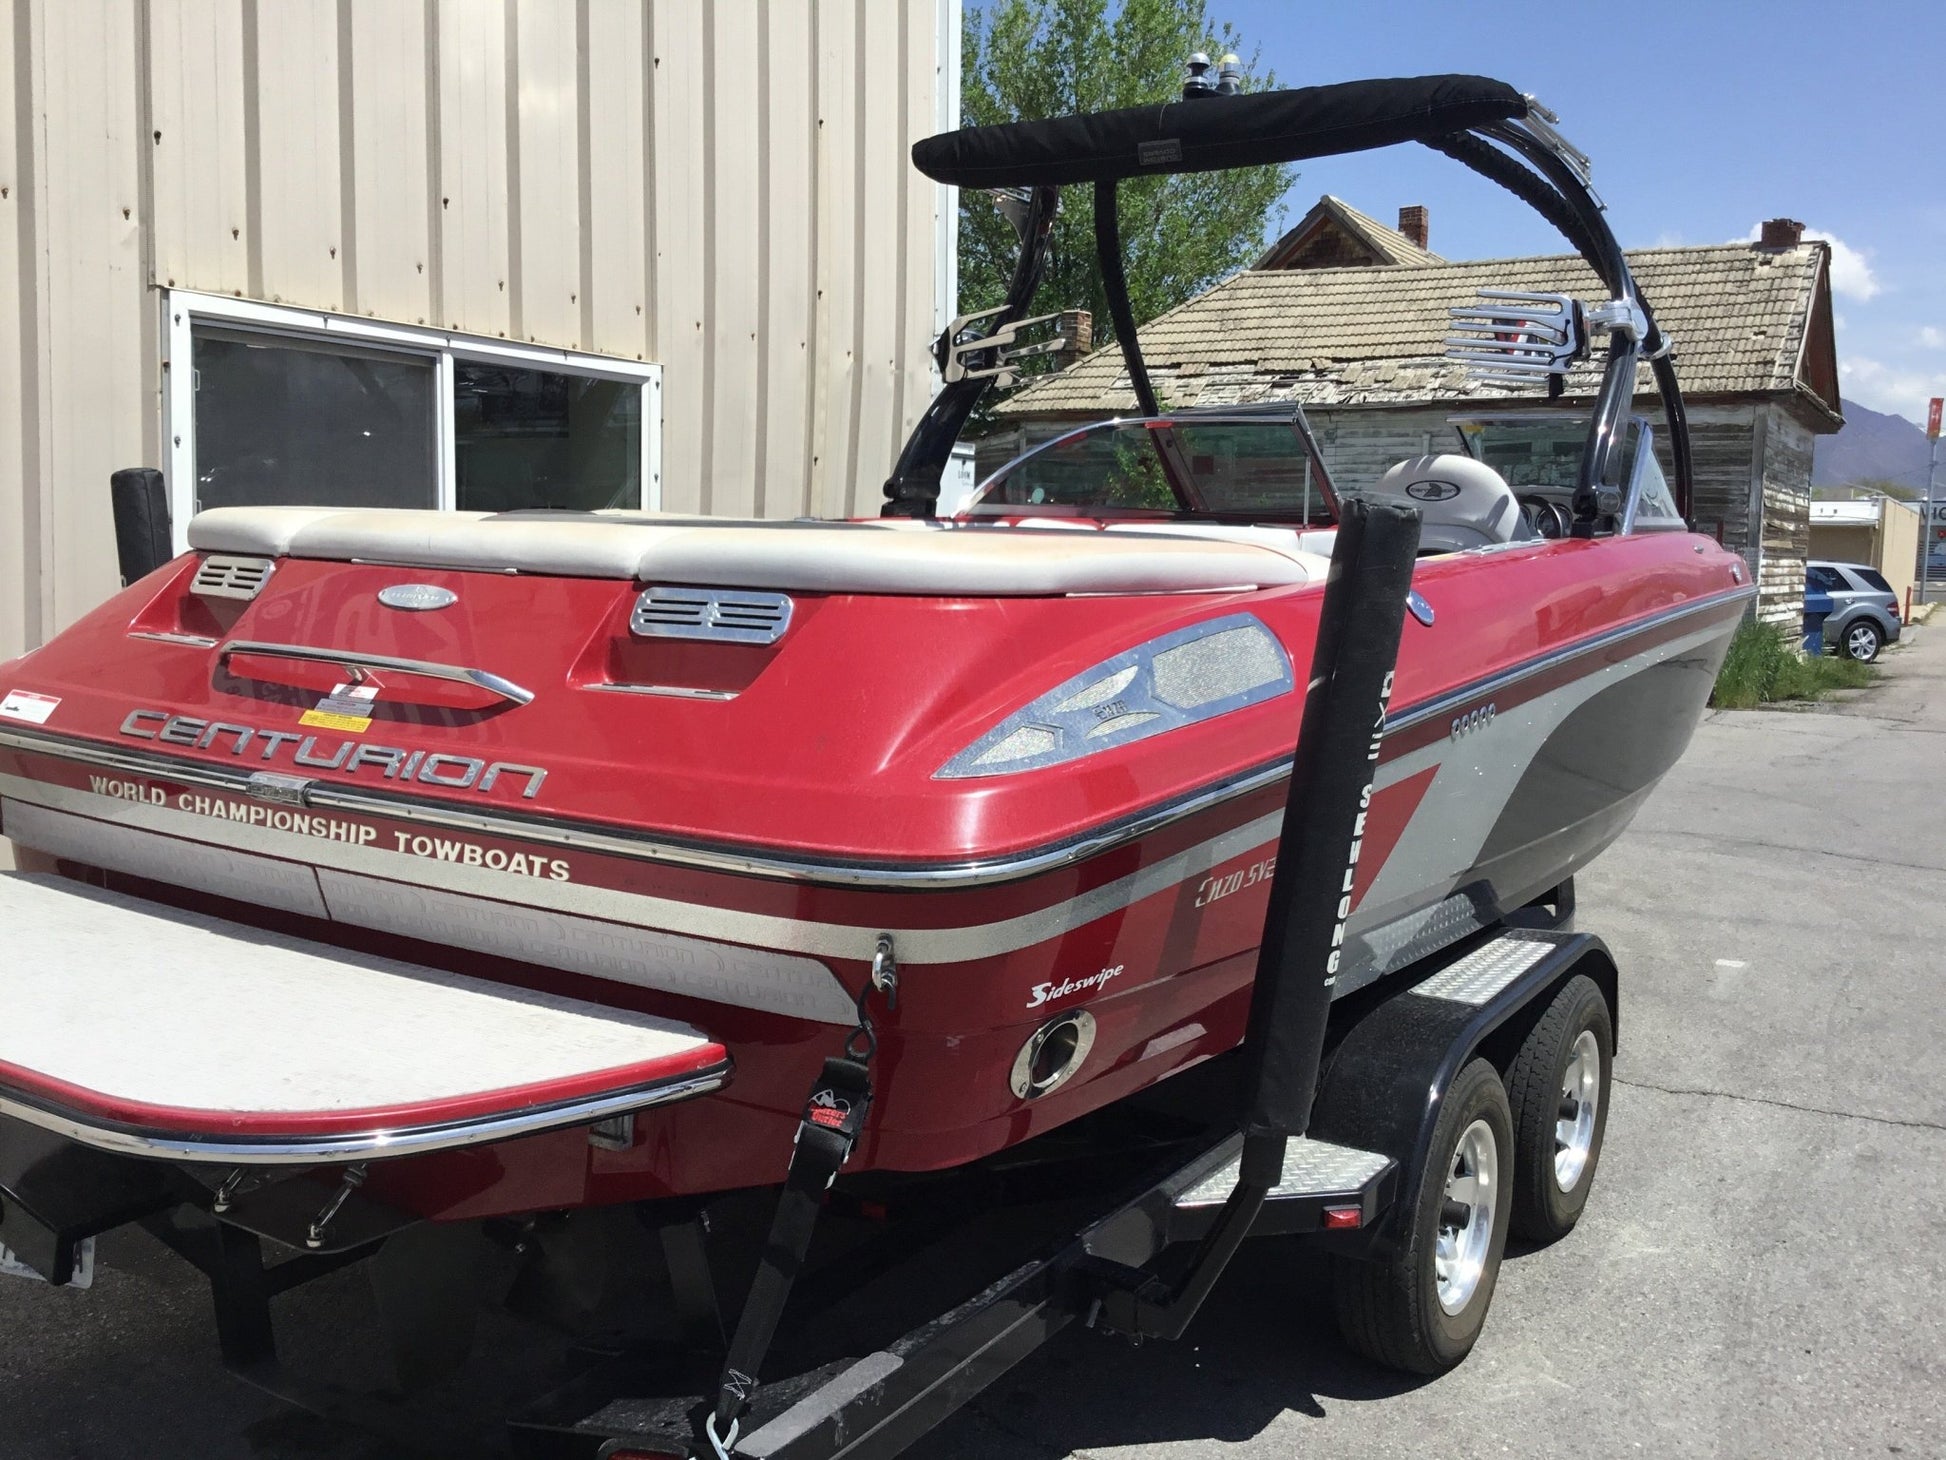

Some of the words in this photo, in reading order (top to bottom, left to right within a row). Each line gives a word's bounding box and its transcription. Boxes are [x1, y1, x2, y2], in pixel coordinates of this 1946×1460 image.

[119, 708, 548, 799] CENTURION
[88, 774, 167, 807] WORLD
[178, 793, 378, 845] CHAMPIONSHIP
[394, 830, 571, 882] TOWBOATS
[1026, 964, 1124, 1009] Sideswipe
